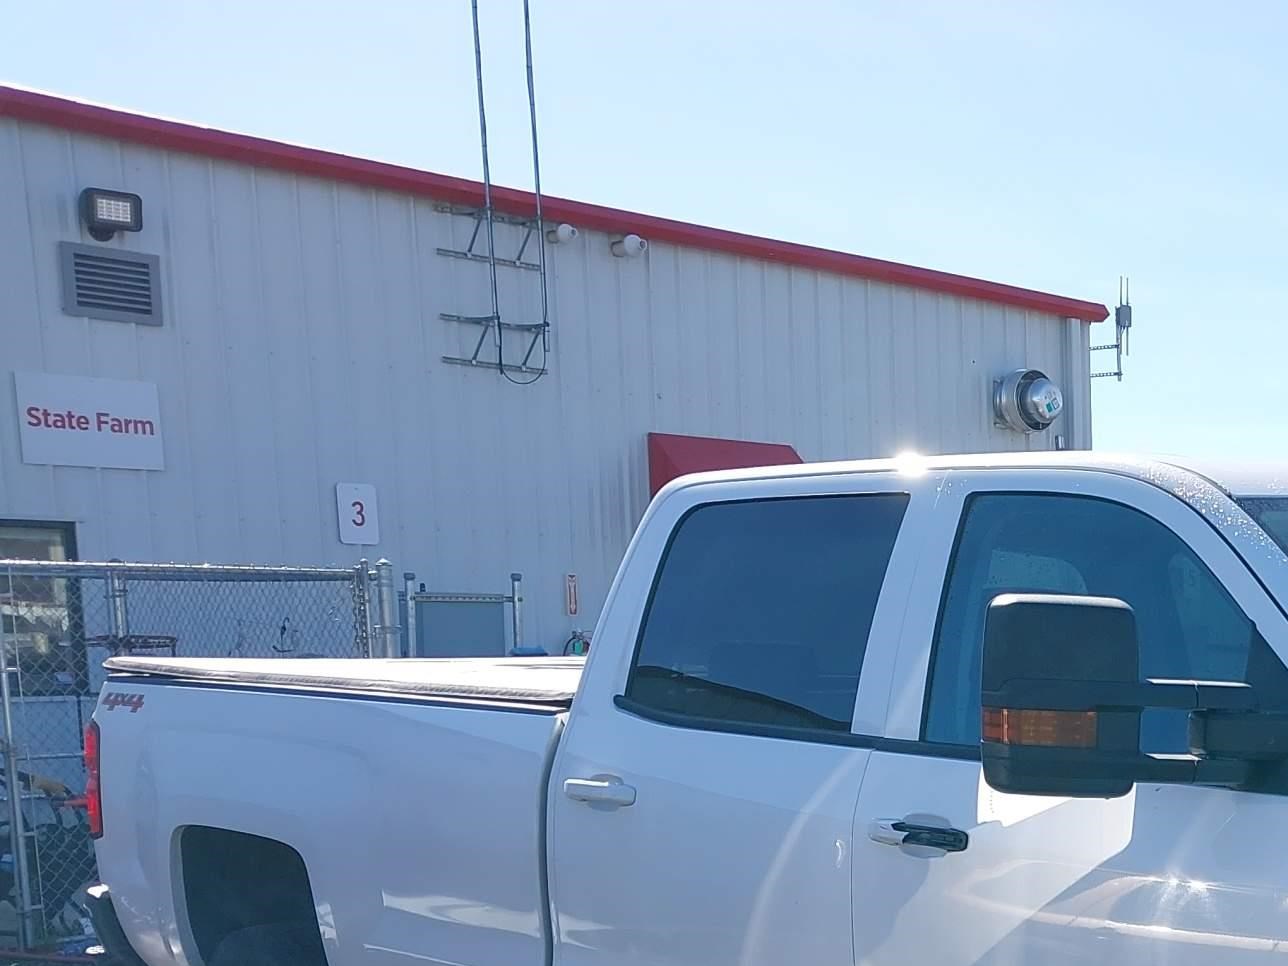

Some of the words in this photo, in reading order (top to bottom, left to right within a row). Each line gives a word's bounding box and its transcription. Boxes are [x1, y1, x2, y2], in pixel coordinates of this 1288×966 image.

[26, 406, 90, 431] State
[95, 412, 154, 436] Farm
[351, 501, 366, 527] 3
